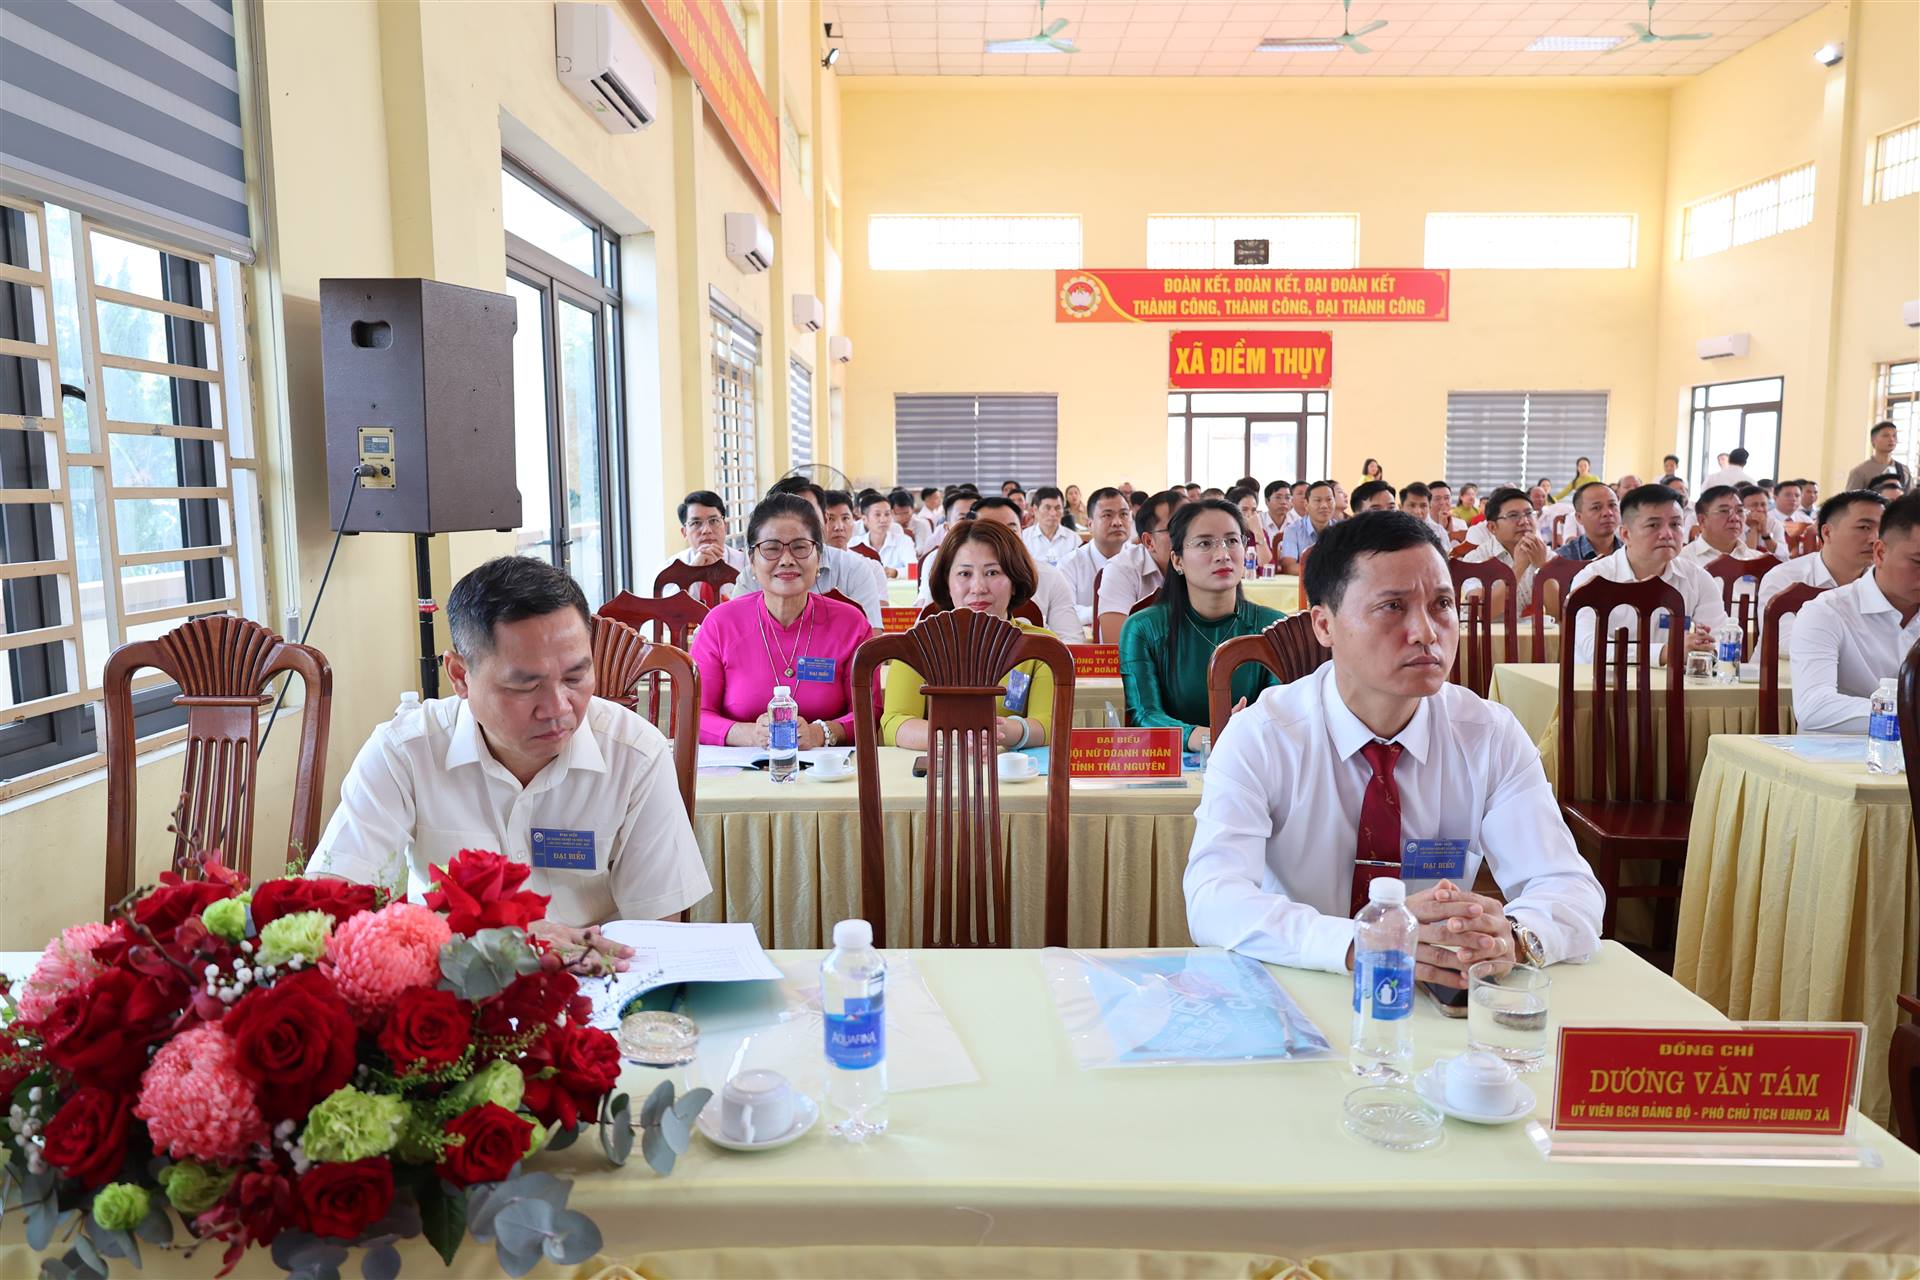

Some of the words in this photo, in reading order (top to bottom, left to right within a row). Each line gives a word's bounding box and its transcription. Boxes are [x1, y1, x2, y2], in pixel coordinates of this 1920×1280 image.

[1164, 274, 1201, 293] ĐOÀN
[1203, 273, 1231, 295] KẾT,
[1234, 274, 1272, 293] ĐOÀN
[1274, 272, 1302, 295] KẾT,
[1304, 275, 1327, 297] ĐẠI
[1331, 273, 1368, 293] ĐOÀN
[1371, 271, 1396, 293] KẾT
[1132, 297, 1176, 315] THÀNH
[1179, 298, 1221, 319] CÔNG,
[1224, 297, 1269, 315] THÀNH
[1271, 298, 1312, 318] CÔNG,
[1315, 298, 1339, 319] ĐẠI
[1342, 297, 1385, 315] THÀNH
[1390, 297, 1425, 315] CÔNG
[1175, 341, 1205, 375] XÃ
[1210, 337, 1266, 375] ĐIỀM
[1272, 346, 1327, 380] THỤY
[1096, 736, 1114, 745] ĐẠI
[1117, 735, 1141, 744] BIỂU
[1071, 747, 1083, 760] ỘI
[1085, 747, 1101, 758] NỮ
[1103, 748, 1139, 758] DOANH
[1141, 746, 1171, 758] NHÂN
[1123, 760, 1166, 772] NGUYÊN
[831, 1031, 877, 1047] AQUAFINA
[1719, 1042, 1755, 1057] CHÍ
[1588, 1066, 1686, 1094] DƯƠNG
[1693, 1065, 1753, 1096] VĂN
[1759, 1065, 1820, 1097] TÁM
[1588, 1103, 1614, 1117] VIÊN
[1616, 1105, 1640, 1118] BCH
[1641, 1101, 1673, 1118] ĐẢNG
[1675, 1104, 1692, 1120] BỘ
[1727, 1102, 1751, 1120] CHỦ
[1752, 1108, 1778, 1122] TỊCH
[1780, 1108, 1812, 1121] UBND
